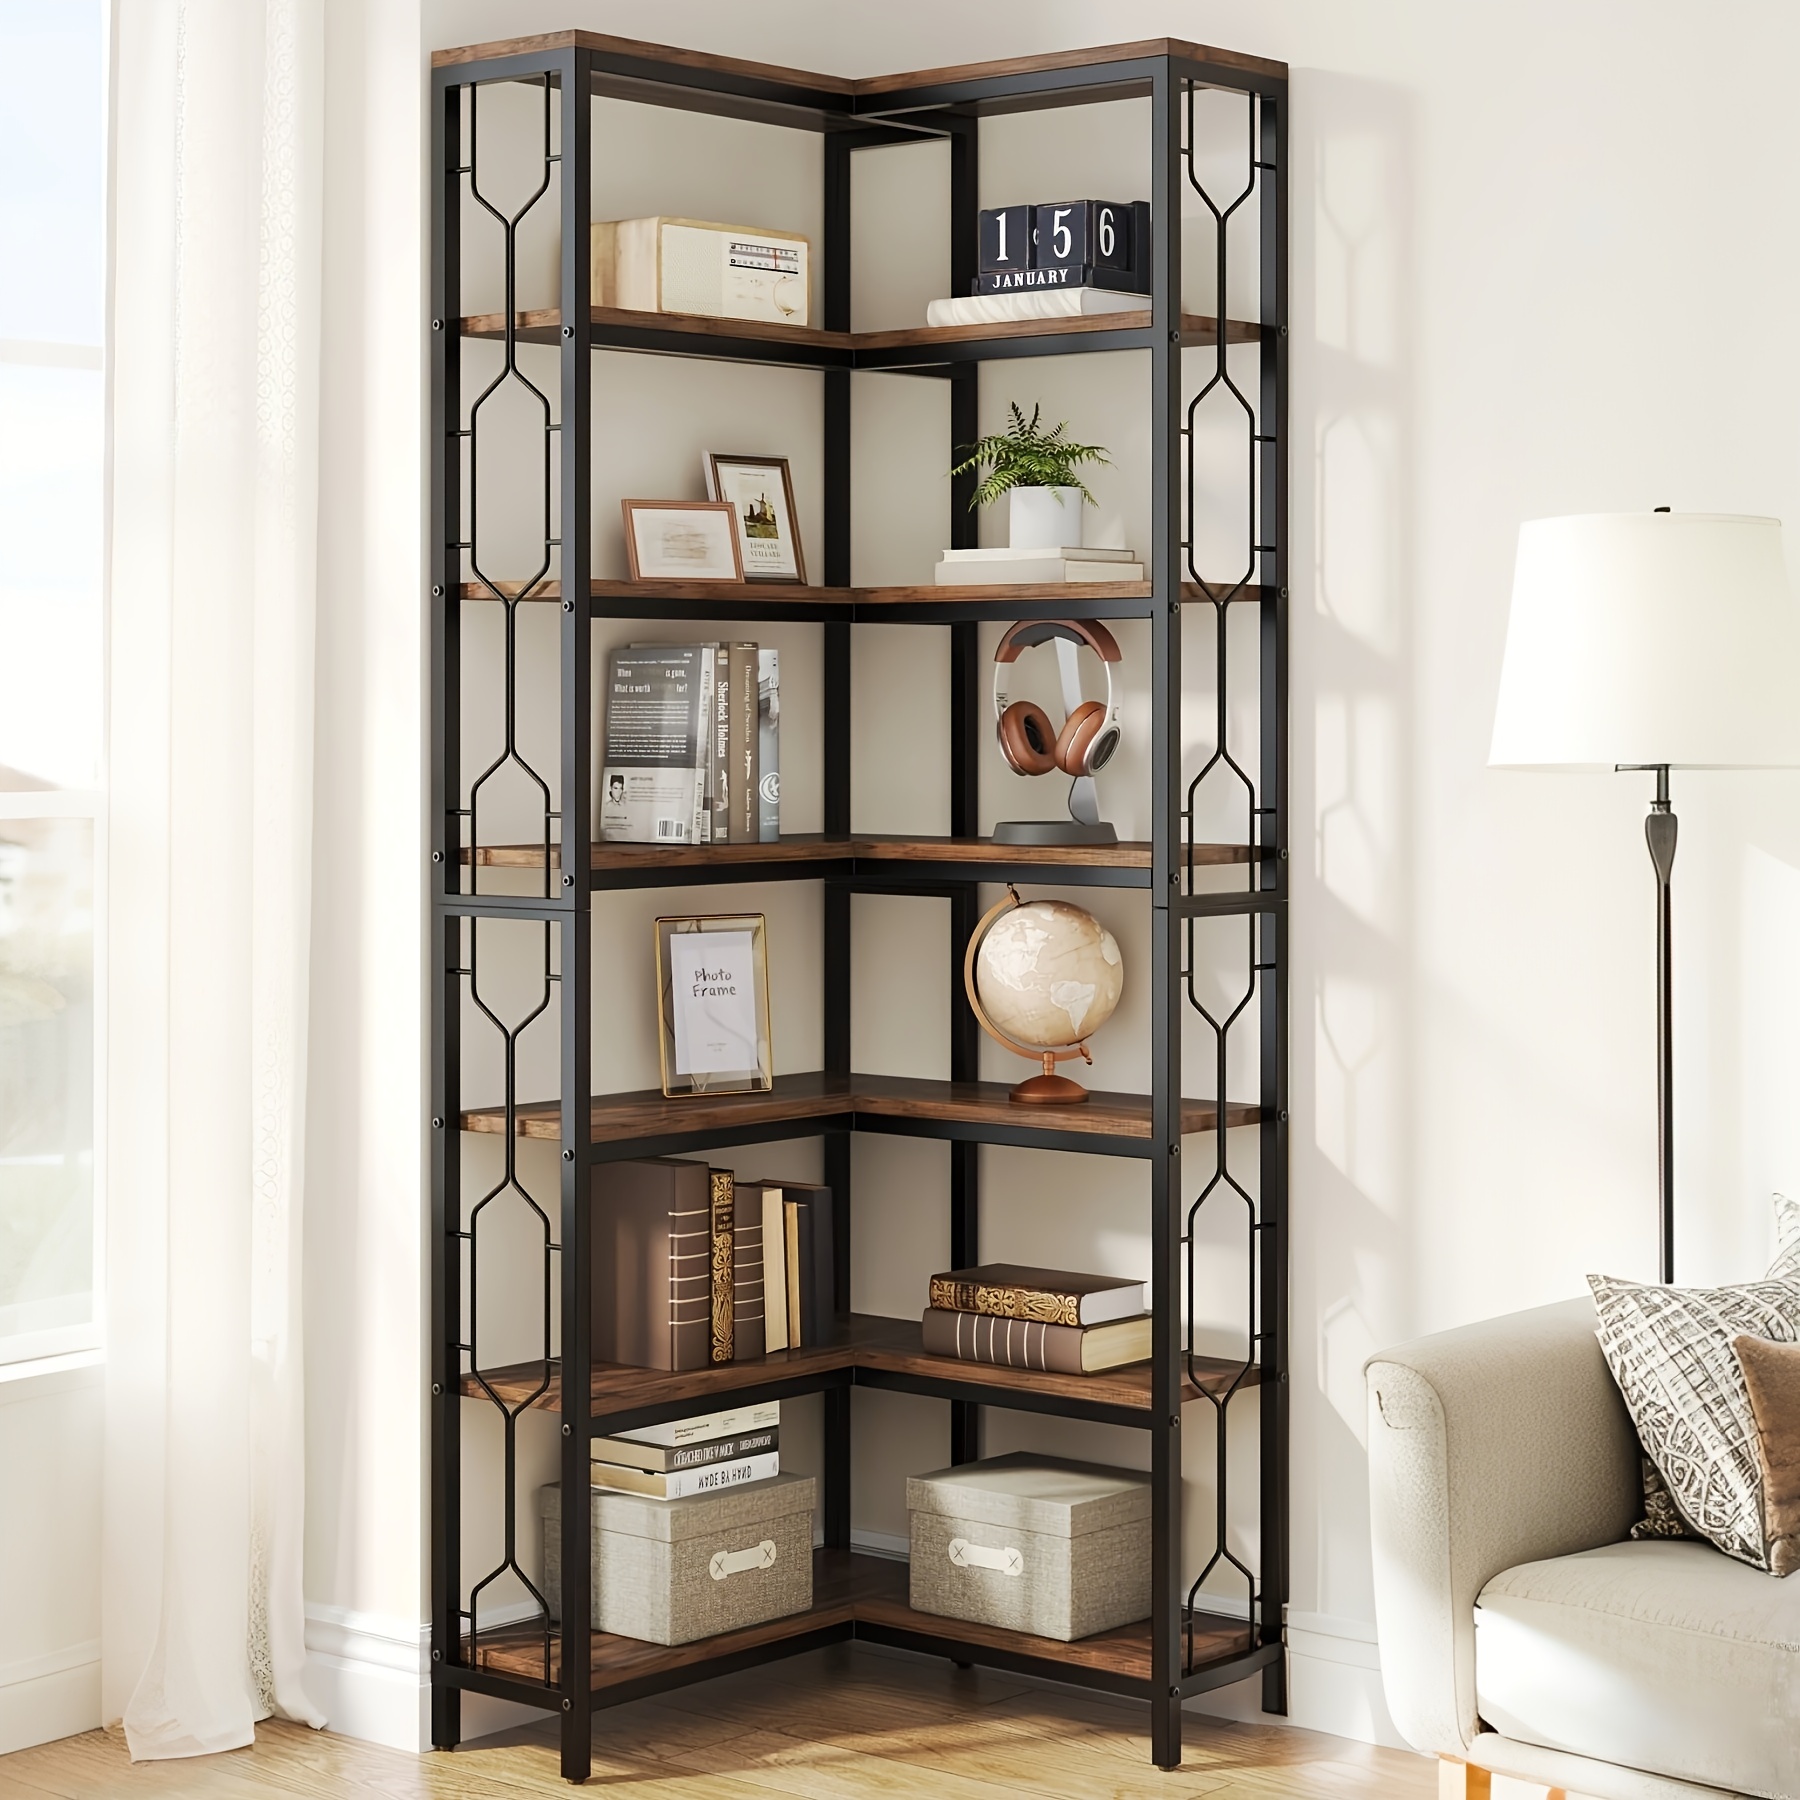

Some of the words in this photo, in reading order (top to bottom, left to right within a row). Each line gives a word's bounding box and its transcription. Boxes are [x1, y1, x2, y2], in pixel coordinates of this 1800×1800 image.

[996, 212, 1009, 261] 1
[1053, 208, 1072, 259] 5
[1099, 208, 1115, 257] 6
[992, 268, 1069, 289] JANUARY
[617, 668, 632, 678] When
[614, 683, 628, 693] What
[634, 683, 651, 693] worth
[717, 681, 729, 721] Sherlock
[717, 724, 729, 758] Holmes
[694, 967, 732, 982] Photo
[692, 983, 737, 997] Frame
